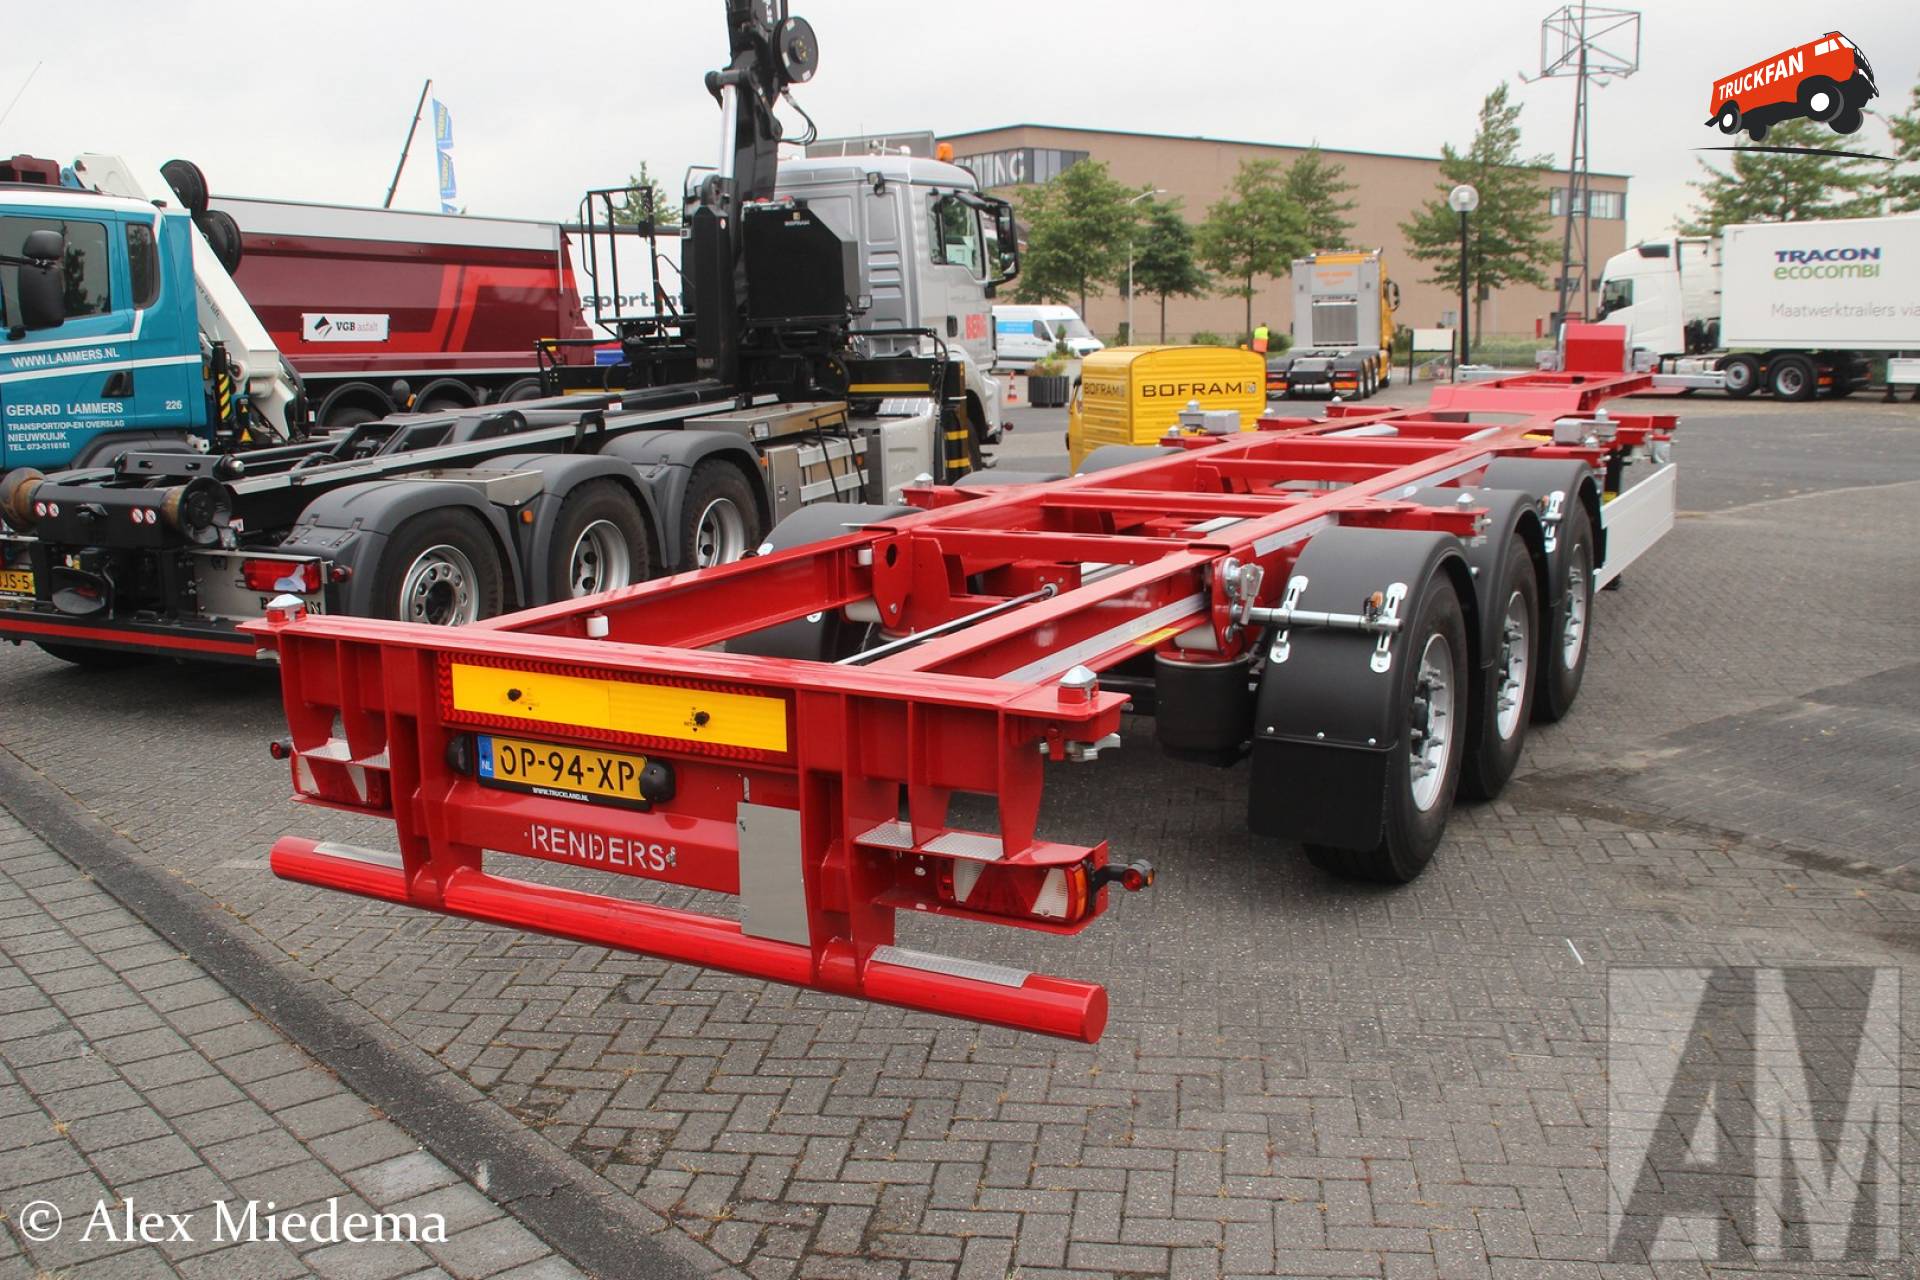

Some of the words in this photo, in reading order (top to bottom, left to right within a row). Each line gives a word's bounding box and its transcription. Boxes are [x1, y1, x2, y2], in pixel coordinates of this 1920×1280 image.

[1774, 247, 1882, 264] TRACON
[1771, 301, 1896, 318] Maatwerktrailers
[336, 321, 356, 332] VGB
[11, 347, 121, 369] WWW.LAMMERS.NL
[1084, 382, 1120, 397] BOFRAM
[1142, 382, 1242, 397] BOFRAM
[6, 403, 61, 417] GERARD
[66, 402, 124, 415] LAMMERS
[165, 400, 183, 410] 226
[86, 420, 125, 429] OVERSLAG
[7, 431, 67, 442] NIEUWKUIJK
[0, 572, 30, 590] JS-5
[480, 759, 493, 772] NL
[500, 744, 635, 791] OP-94-XP
[531, 823, 666, 872] RENDERS
